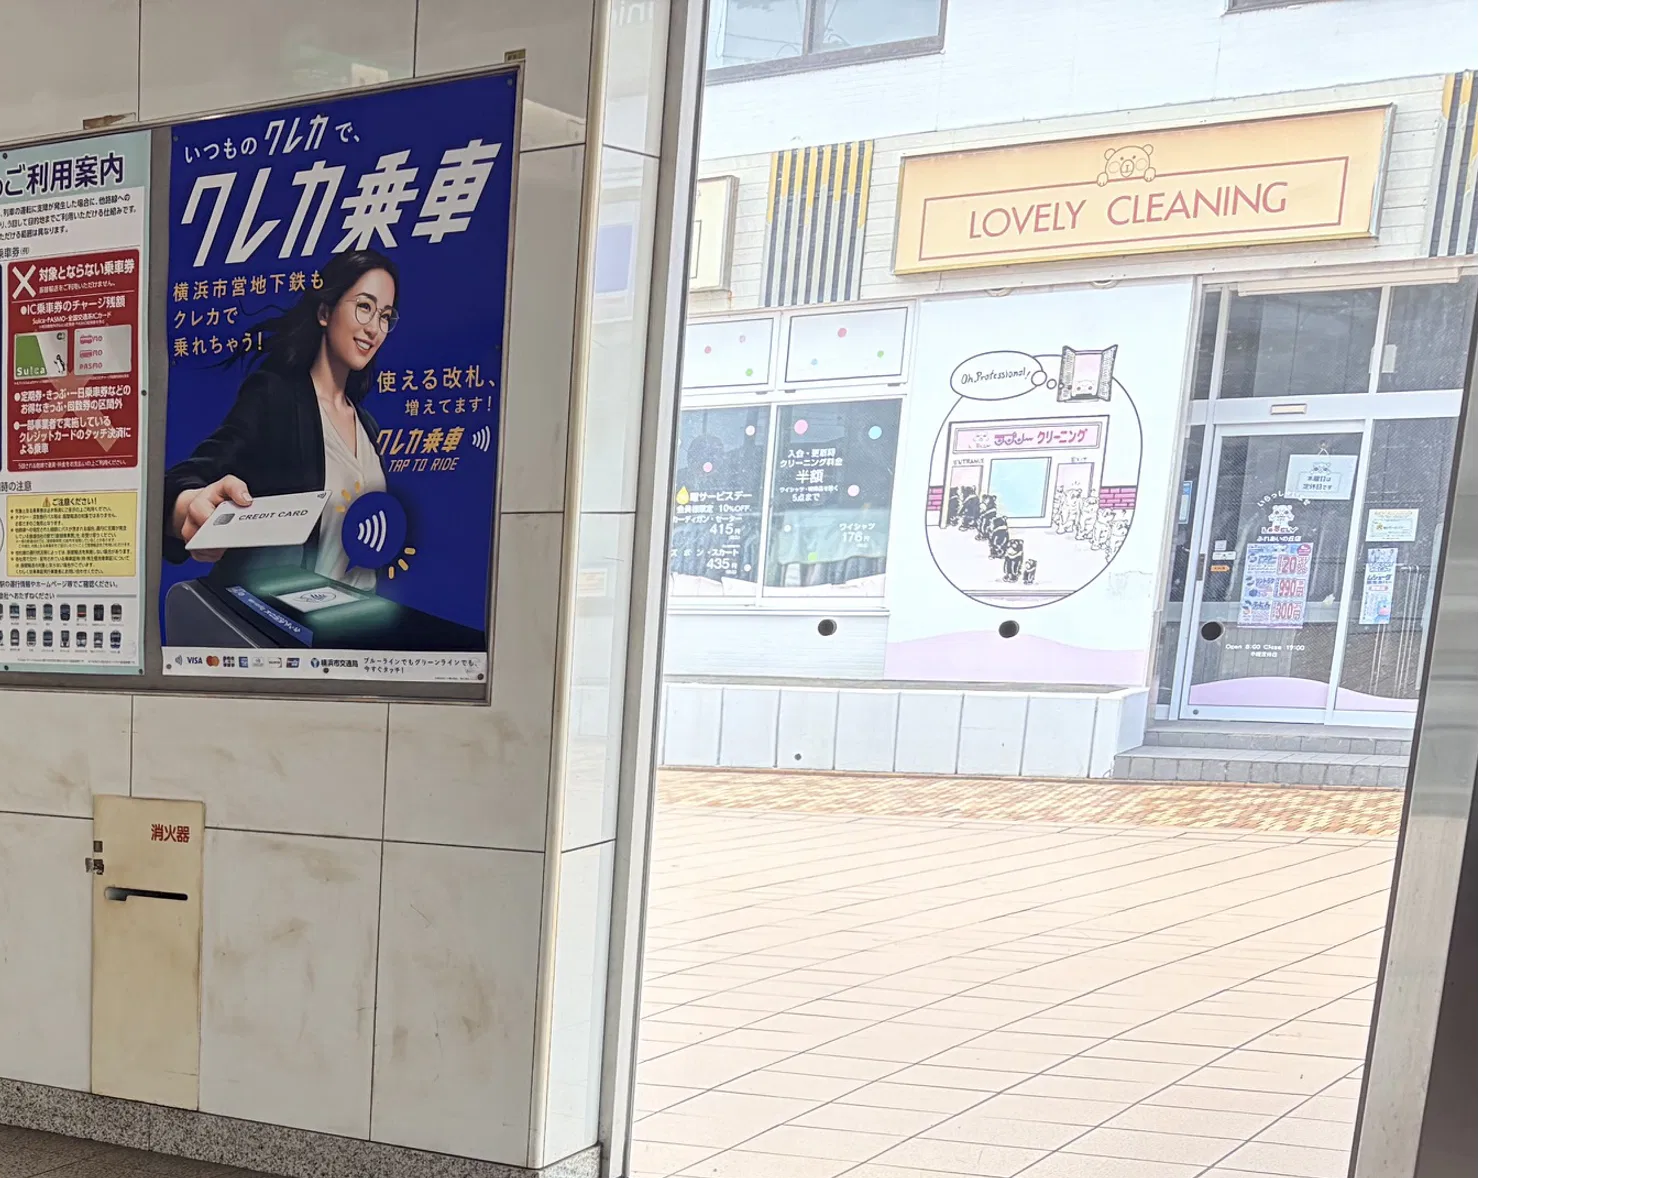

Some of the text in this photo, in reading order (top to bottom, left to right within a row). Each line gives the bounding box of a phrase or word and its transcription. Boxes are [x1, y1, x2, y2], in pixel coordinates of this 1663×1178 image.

[181, 139, 502, 267] クレカ乗車
[969, 181, 1288, 239] LOVELY CLEANING
[39, 259, 134, 282] 対象とならない乗車券
[173, 271, 324, 302] 横浜市営地下鉄も
[173, 307, 237, 329] クレカで
[17, 365, 45, 375] Suica
[377, 365, 496, 393] 使える改札、
[376, 427, 465, 455] クレカ乗車
[1037, 429, 1088, 444] クリーニング
[389, 457, 460, 472] TAP TO RIDE
[780, 458, 842, 467] クリーニング料金
[796, 470, 823, 483] 半額
[239, 510, 308, 520] CREDIT CARD
[187, 656, 202, 665] VISA
[321, 659, 358, 668] 横浜市交通局
[151, 824, 189, 843] 消火器
